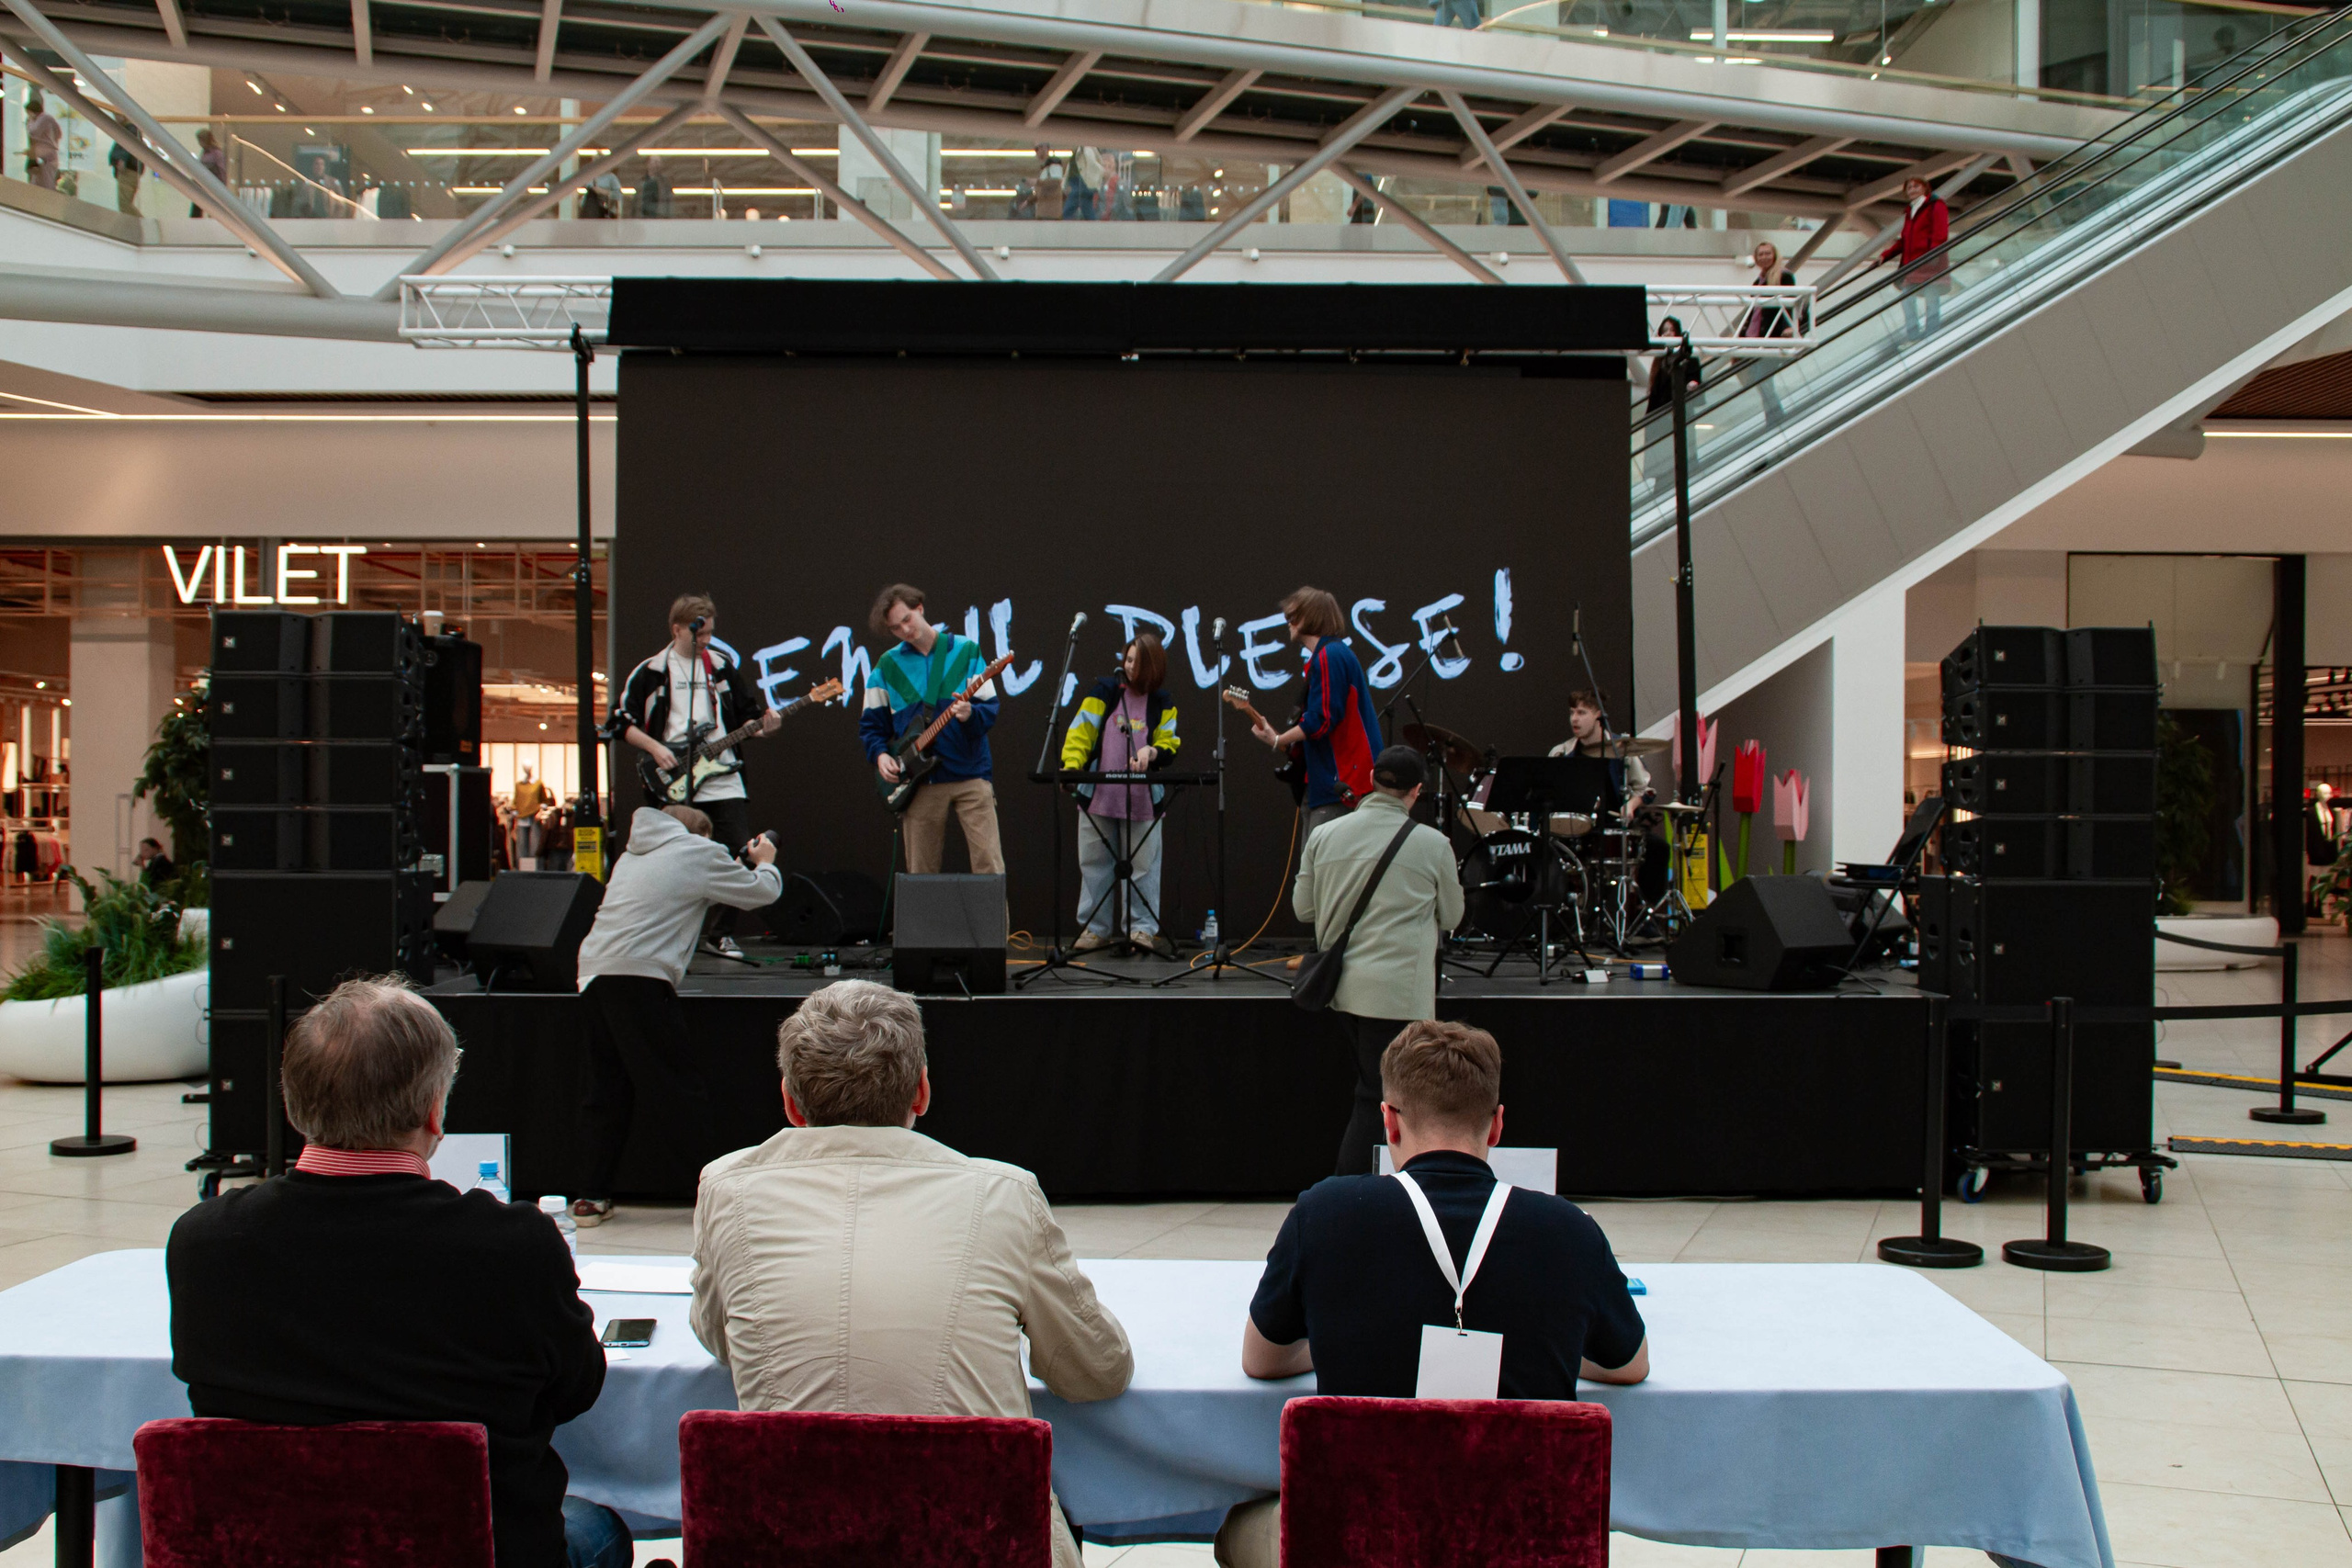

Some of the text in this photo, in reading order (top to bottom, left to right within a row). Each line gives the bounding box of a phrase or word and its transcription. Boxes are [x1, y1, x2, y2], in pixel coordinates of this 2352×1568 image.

[164, 546, 367, 604] VILET
[1104, 568, 1525, 691] PLESE!
[1497, 842, 1532, 856] TAMA
